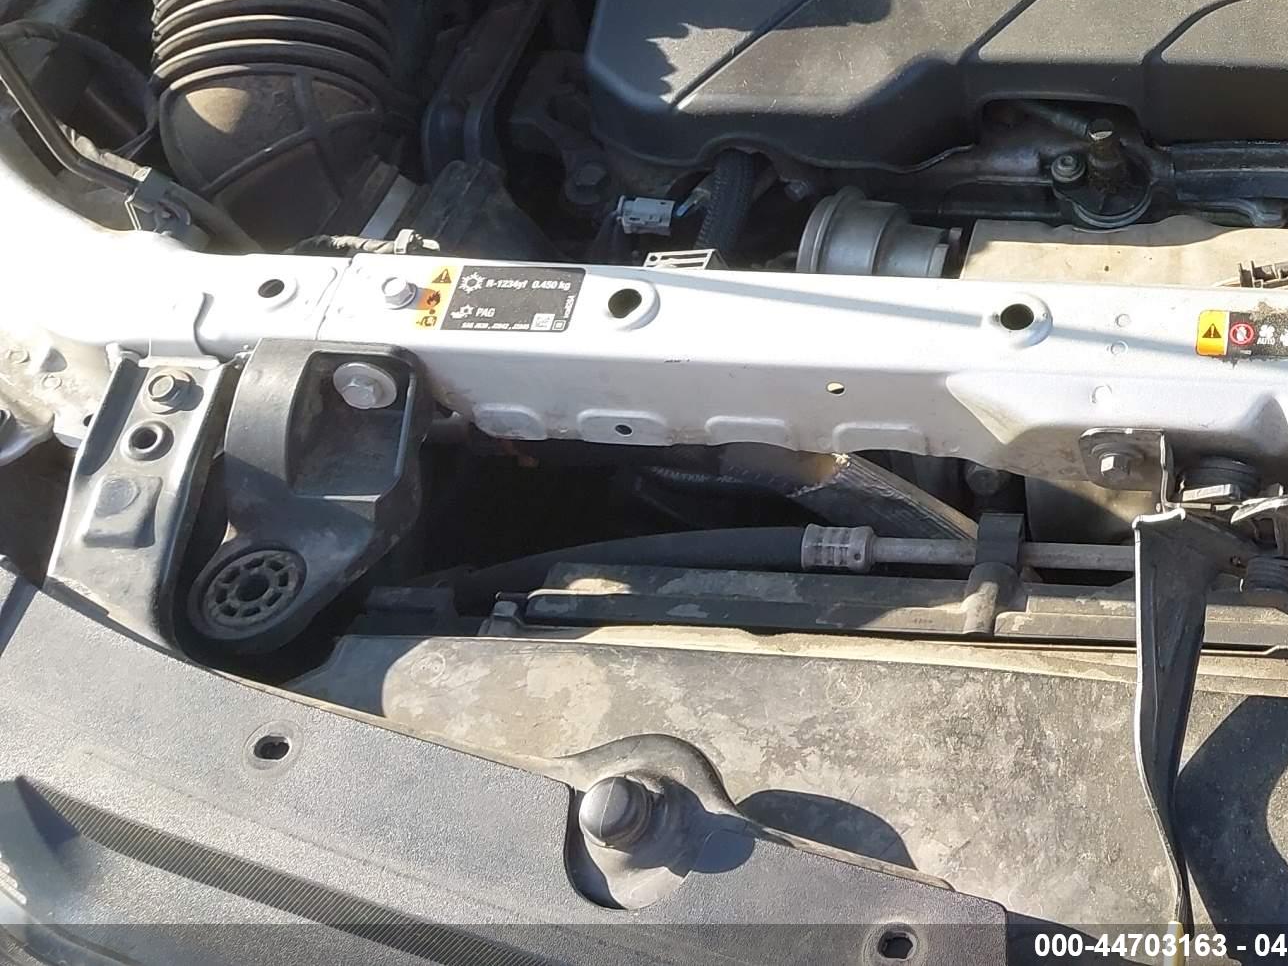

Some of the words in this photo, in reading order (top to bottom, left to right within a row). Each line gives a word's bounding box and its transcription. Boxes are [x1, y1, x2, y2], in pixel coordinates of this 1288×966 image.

[558, 281, 571, 290] kg
[475, 307, 496, 318] PAG
[1257, 337, 1276, 346] AUTO
